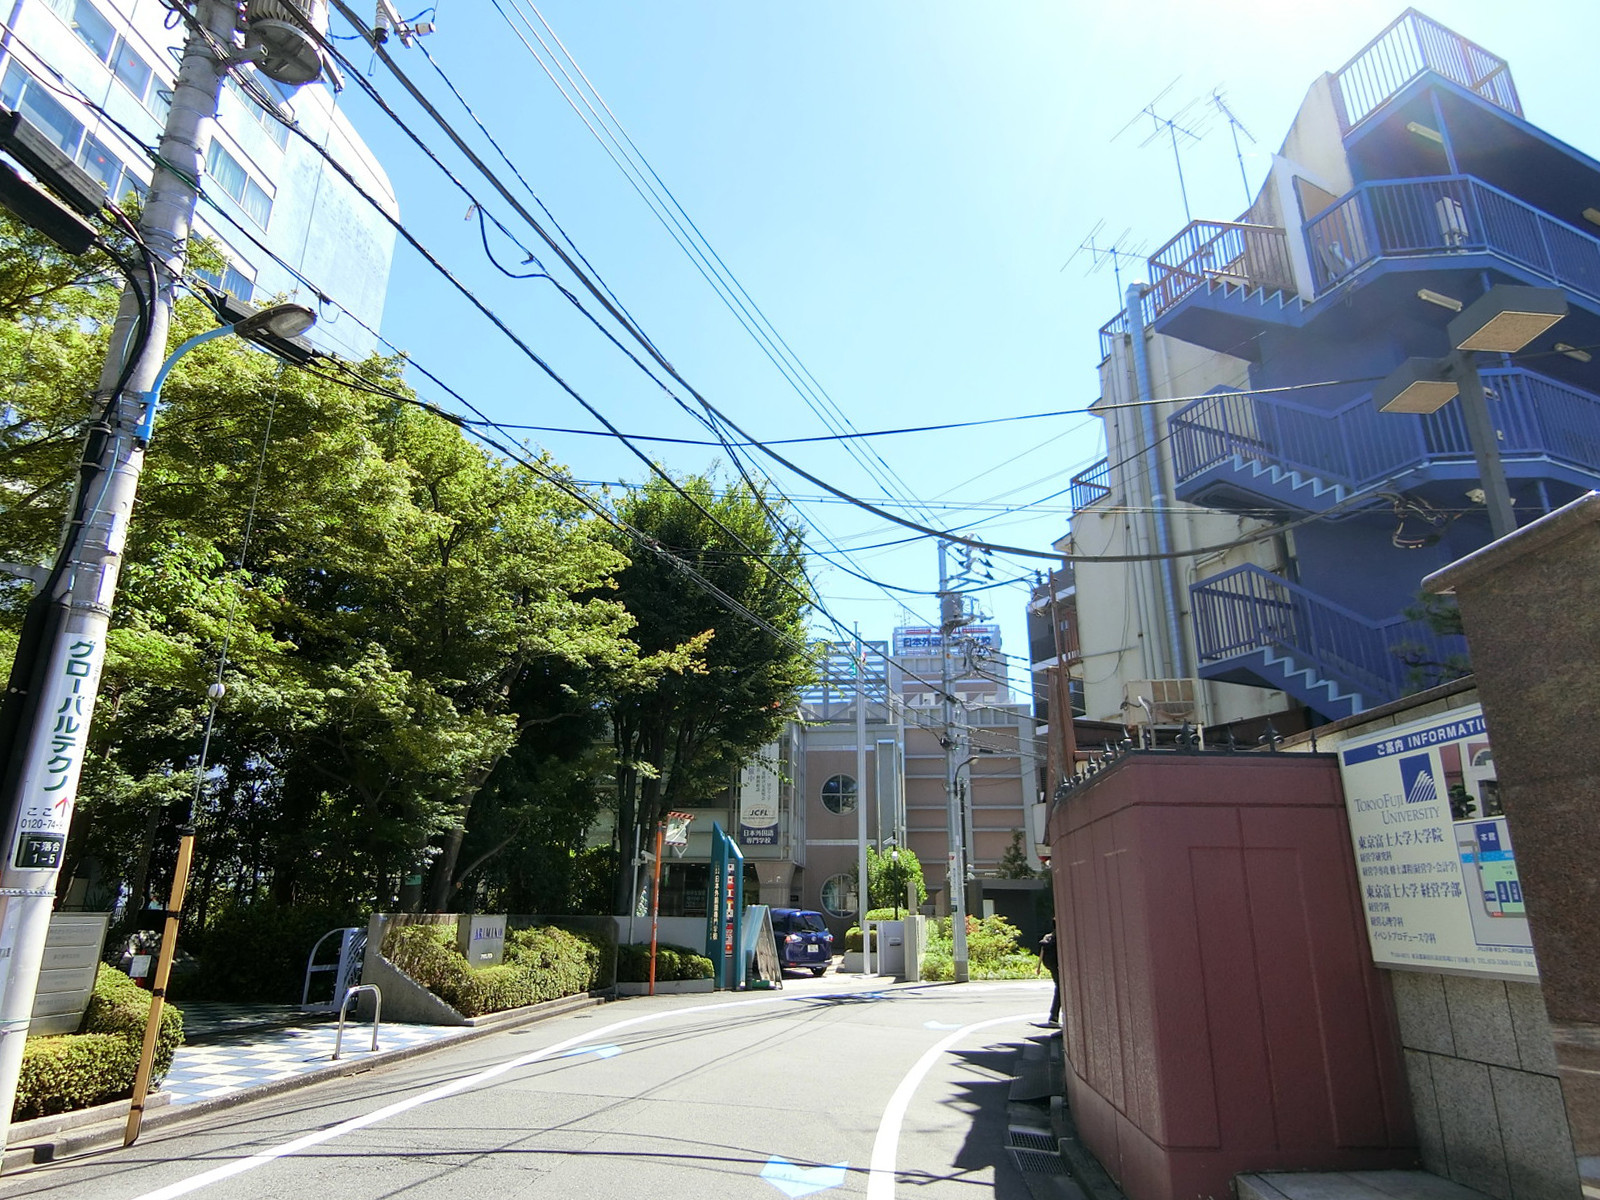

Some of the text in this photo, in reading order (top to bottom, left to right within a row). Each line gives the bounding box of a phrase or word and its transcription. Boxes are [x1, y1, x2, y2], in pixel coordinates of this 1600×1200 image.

[43, 640, 97, 791] グローバルテクノ
[1377, 740, 1404, 755] ご案内
[27, 807, 52, 816] ここ
[1381, 806, 1440, 825] UNIVERSITY
[743, 829, 774, 837] 日本外国語
[1359, 827, 1444, 849] 東京富士大学大学院
[30, 841, 60, 852] 下落合
[746, 837, 771, 845] 専門学校
[33, 853, 56, 864] 1-5
[1366, 881, 1462, 898] 東京富士大学 経営学部
